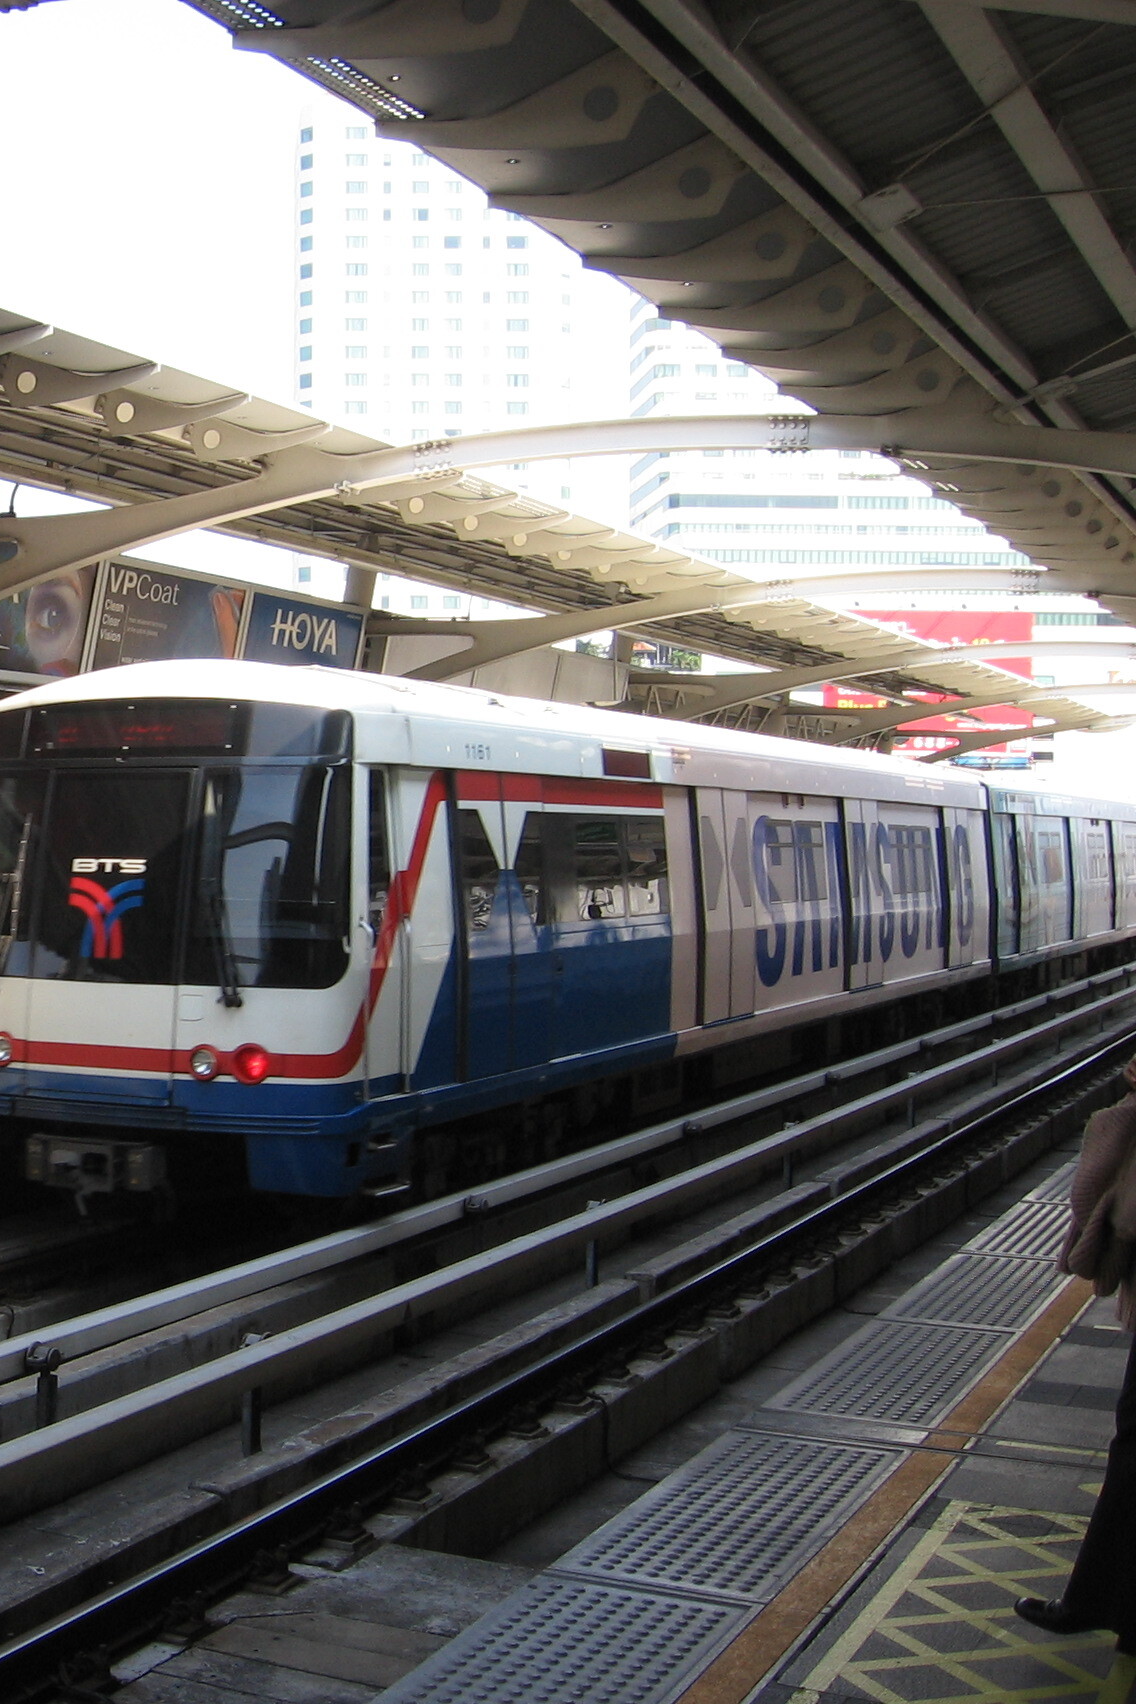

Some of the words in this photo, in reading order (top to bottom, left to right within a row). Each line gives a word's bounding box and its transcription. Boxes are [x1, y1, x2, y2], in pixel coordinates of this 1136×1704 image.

[104, 598, 125, 613] Clean
[110, 566, 180, 606] VPCoat
[270, 608, 337, 656] HOYA
[71, 858, 148, 873] BTS
[753, 814, 975, 988] SAMSUNG
